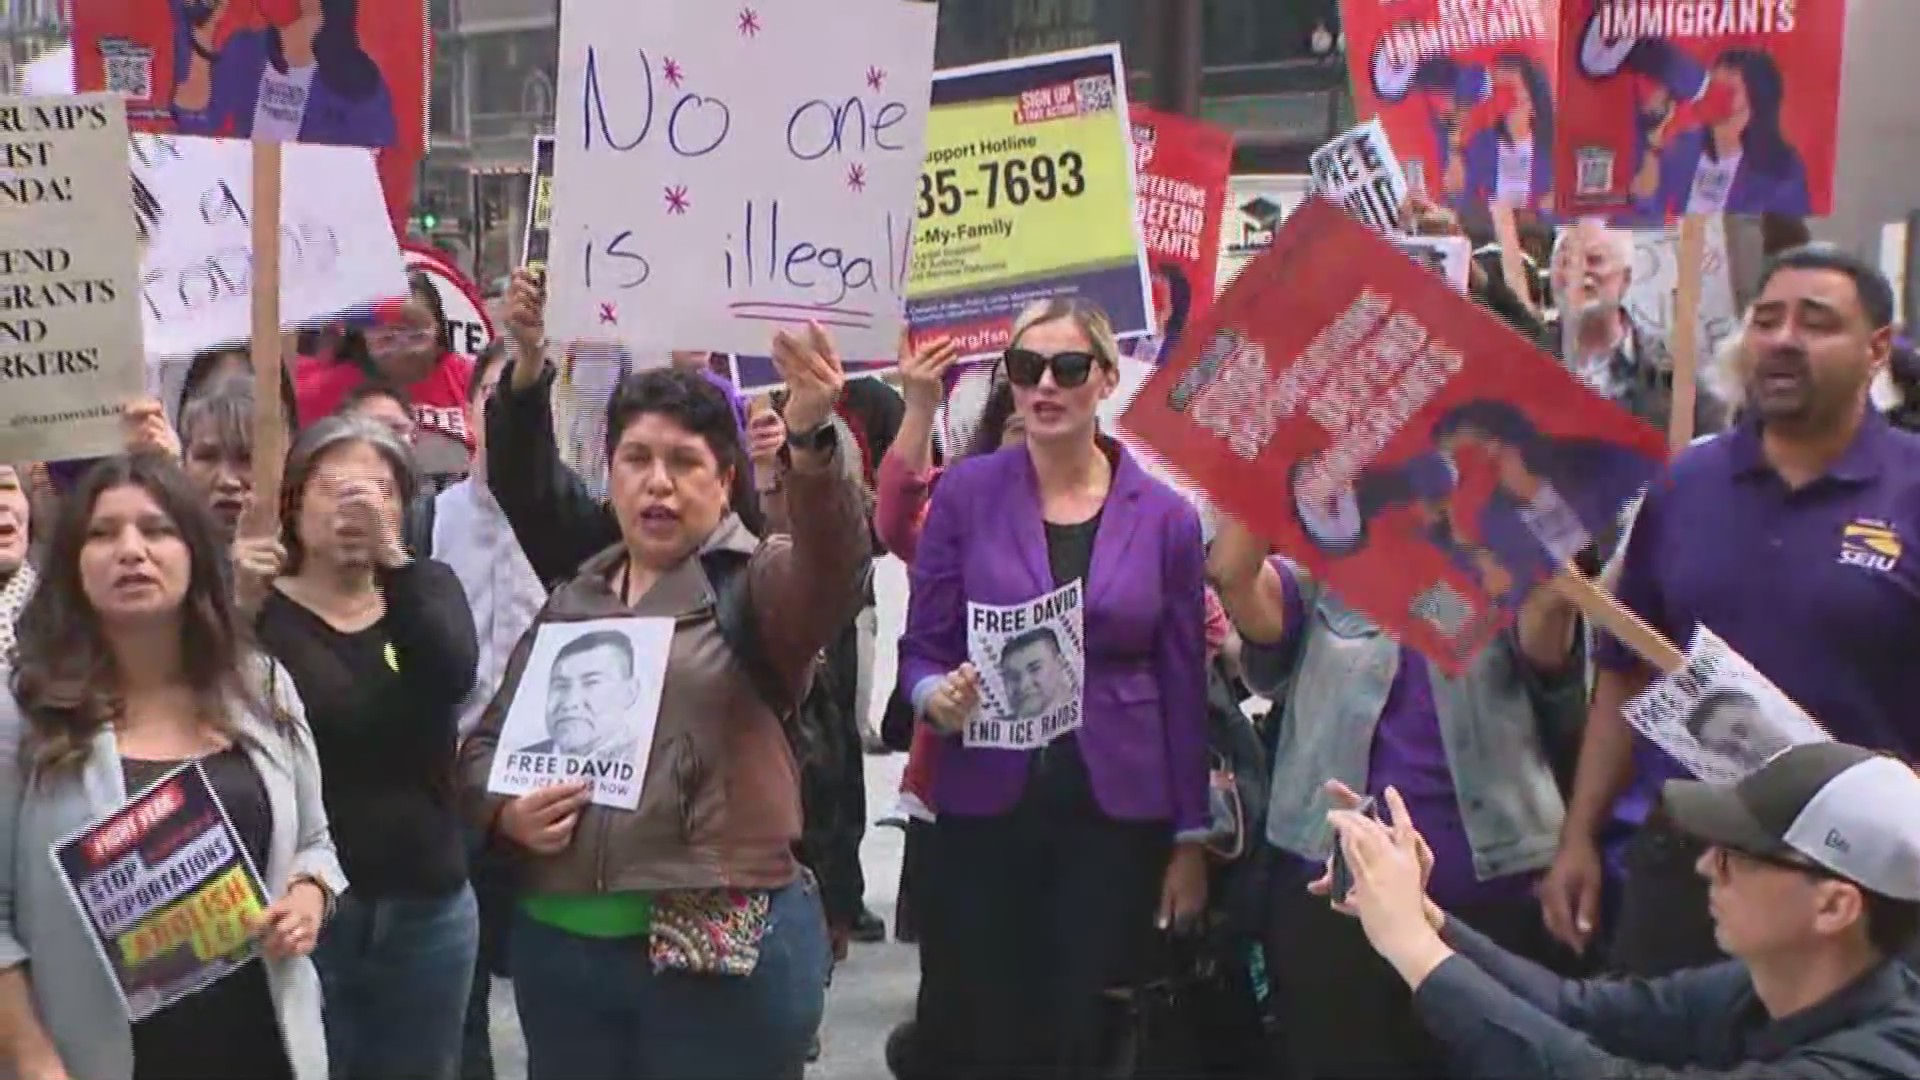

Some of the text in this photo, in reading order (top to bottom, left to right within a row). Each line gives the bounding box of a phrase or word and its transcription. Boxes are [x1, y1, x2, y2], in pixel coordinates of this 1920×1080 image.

[1600, 0, 1796, 38] IMMIGRANTS
[584, 45, 908, 160] No one
[980, 135, 1037, 155] Hotline
[916, 150, 1085, 219] 35-7693
[584, 224, 650, 289] is
[973, 587, 1078, 633] FREE DAVID
[969, 700, 1079, 744] END ICE RAIDS
[506, 754, 633, 781] FREE DAVID
[600, 784, 629, 796] NOW
[88, 862, 137, 904] STOP
